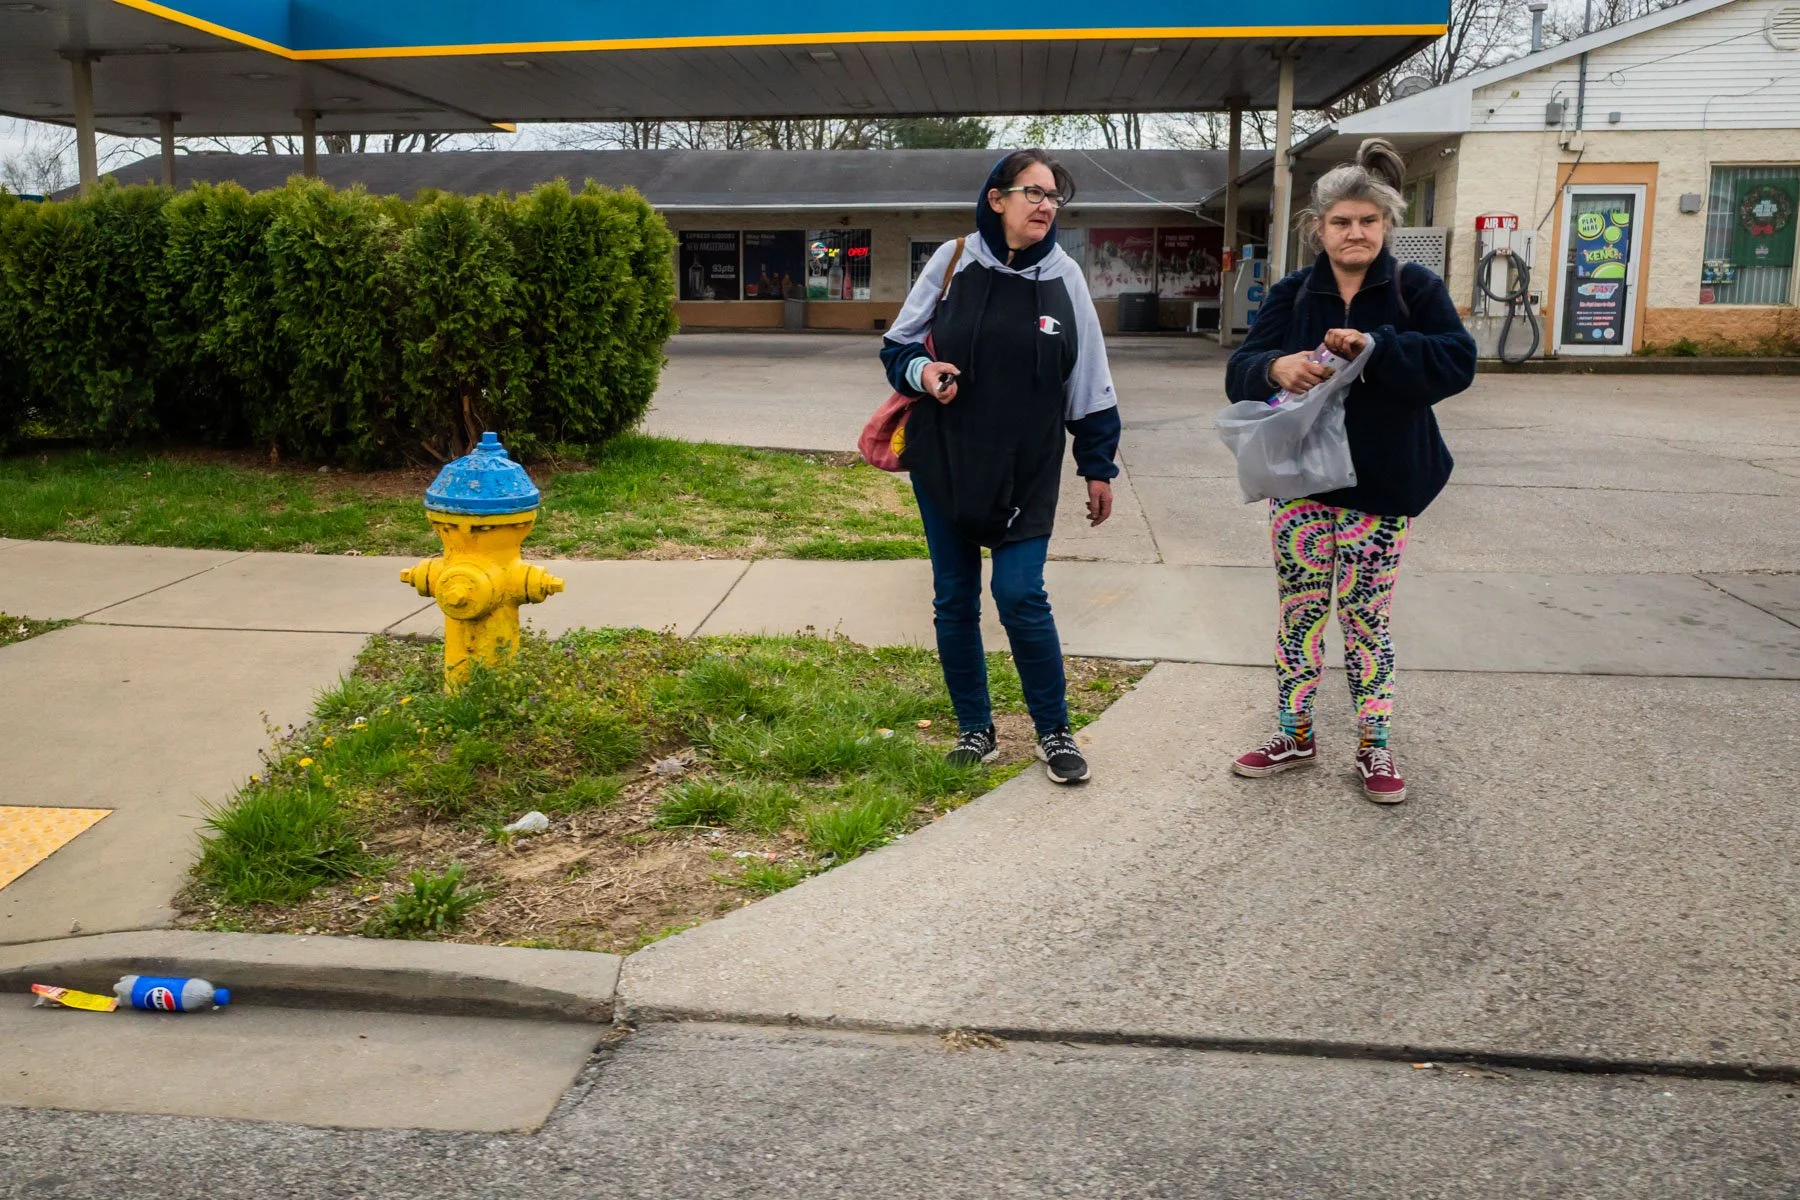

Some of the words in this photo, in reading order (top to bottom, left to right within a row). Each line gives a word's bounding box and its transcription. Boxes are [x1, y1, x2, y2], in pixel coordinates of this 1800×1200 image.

[1484, 217, 1499, 228] AIR
[1502, 217, 1517, 228] VAC
[848, 247, 869, 257] OPEN
[1586, 247, 1619, 263] KENO
